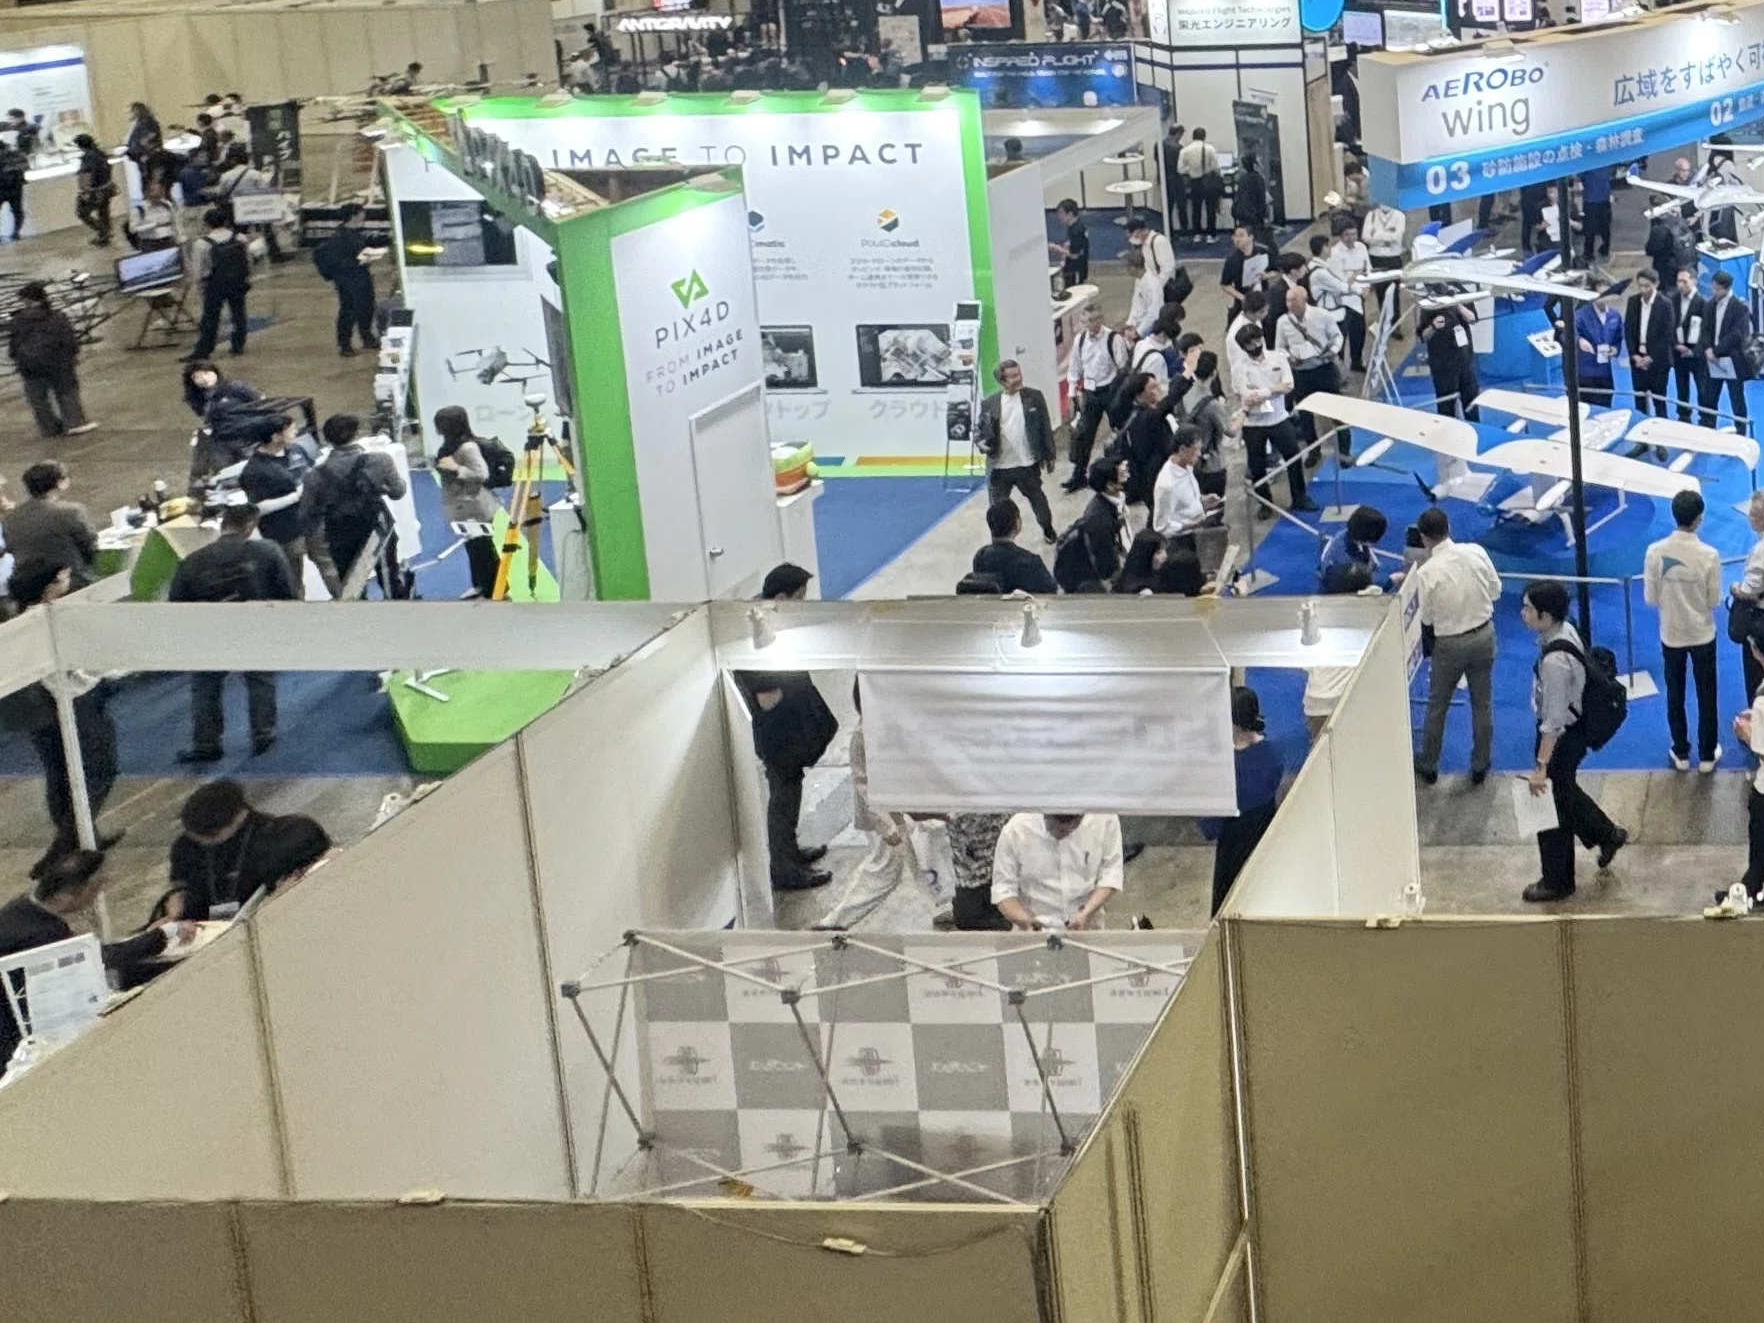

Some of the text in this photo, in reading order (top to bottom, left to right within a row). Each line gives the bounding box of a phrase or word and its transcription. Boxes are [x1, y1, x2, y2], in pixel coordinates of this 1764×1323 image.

[618, 15, 733, 33] ANTIGRAVITY
[1178, 16, 1292, 29] 栄光エンジニアリング
[1212, 5, 1236, 16] Flight
[1421, 67, 1545, 103] AEROBO
[1441, 98, 1531, 138] wing
[1710, 98, 1734, 126] 02
[552, 142, 923, 169] IMAGE TO IMPACT
[1426, 160, 1471, 195] 03
[655, 300, 730, 349] PIX4D
[646, 328, 744, 384] FROM IMAGE
[656, 348, 739, 397] TO IMPACT
